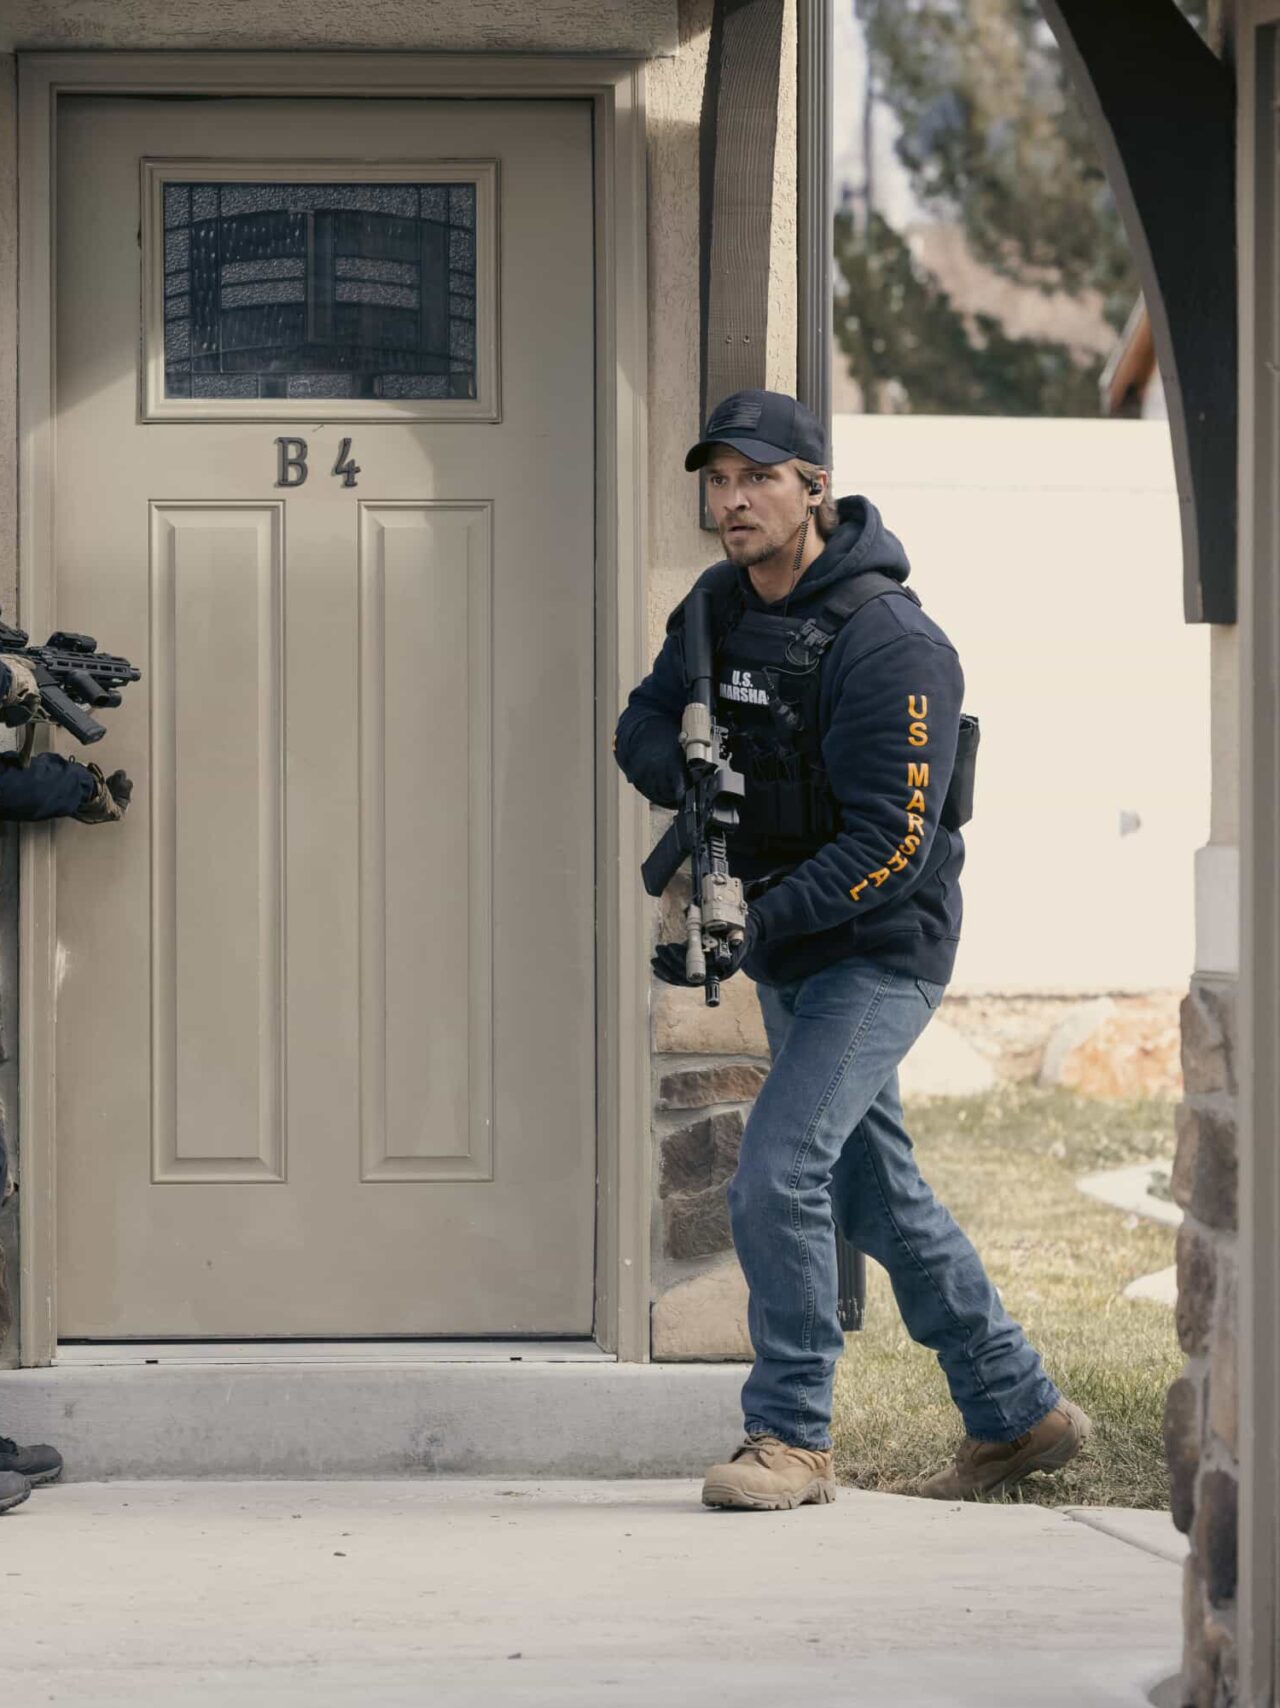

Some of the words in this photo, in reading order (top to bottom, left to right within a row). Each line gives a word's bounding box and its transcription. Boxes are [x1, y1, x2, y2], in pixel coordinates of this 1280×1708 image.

[274, 436, 308, 488] B
[331, 437, 361, 488] 4
[719, 682, 770, 705] MARSHA
[732, 669, 754, 688] U.S.
[907, 695, 929, 747] US
[849, 762, 929, 901] MARSHAL
